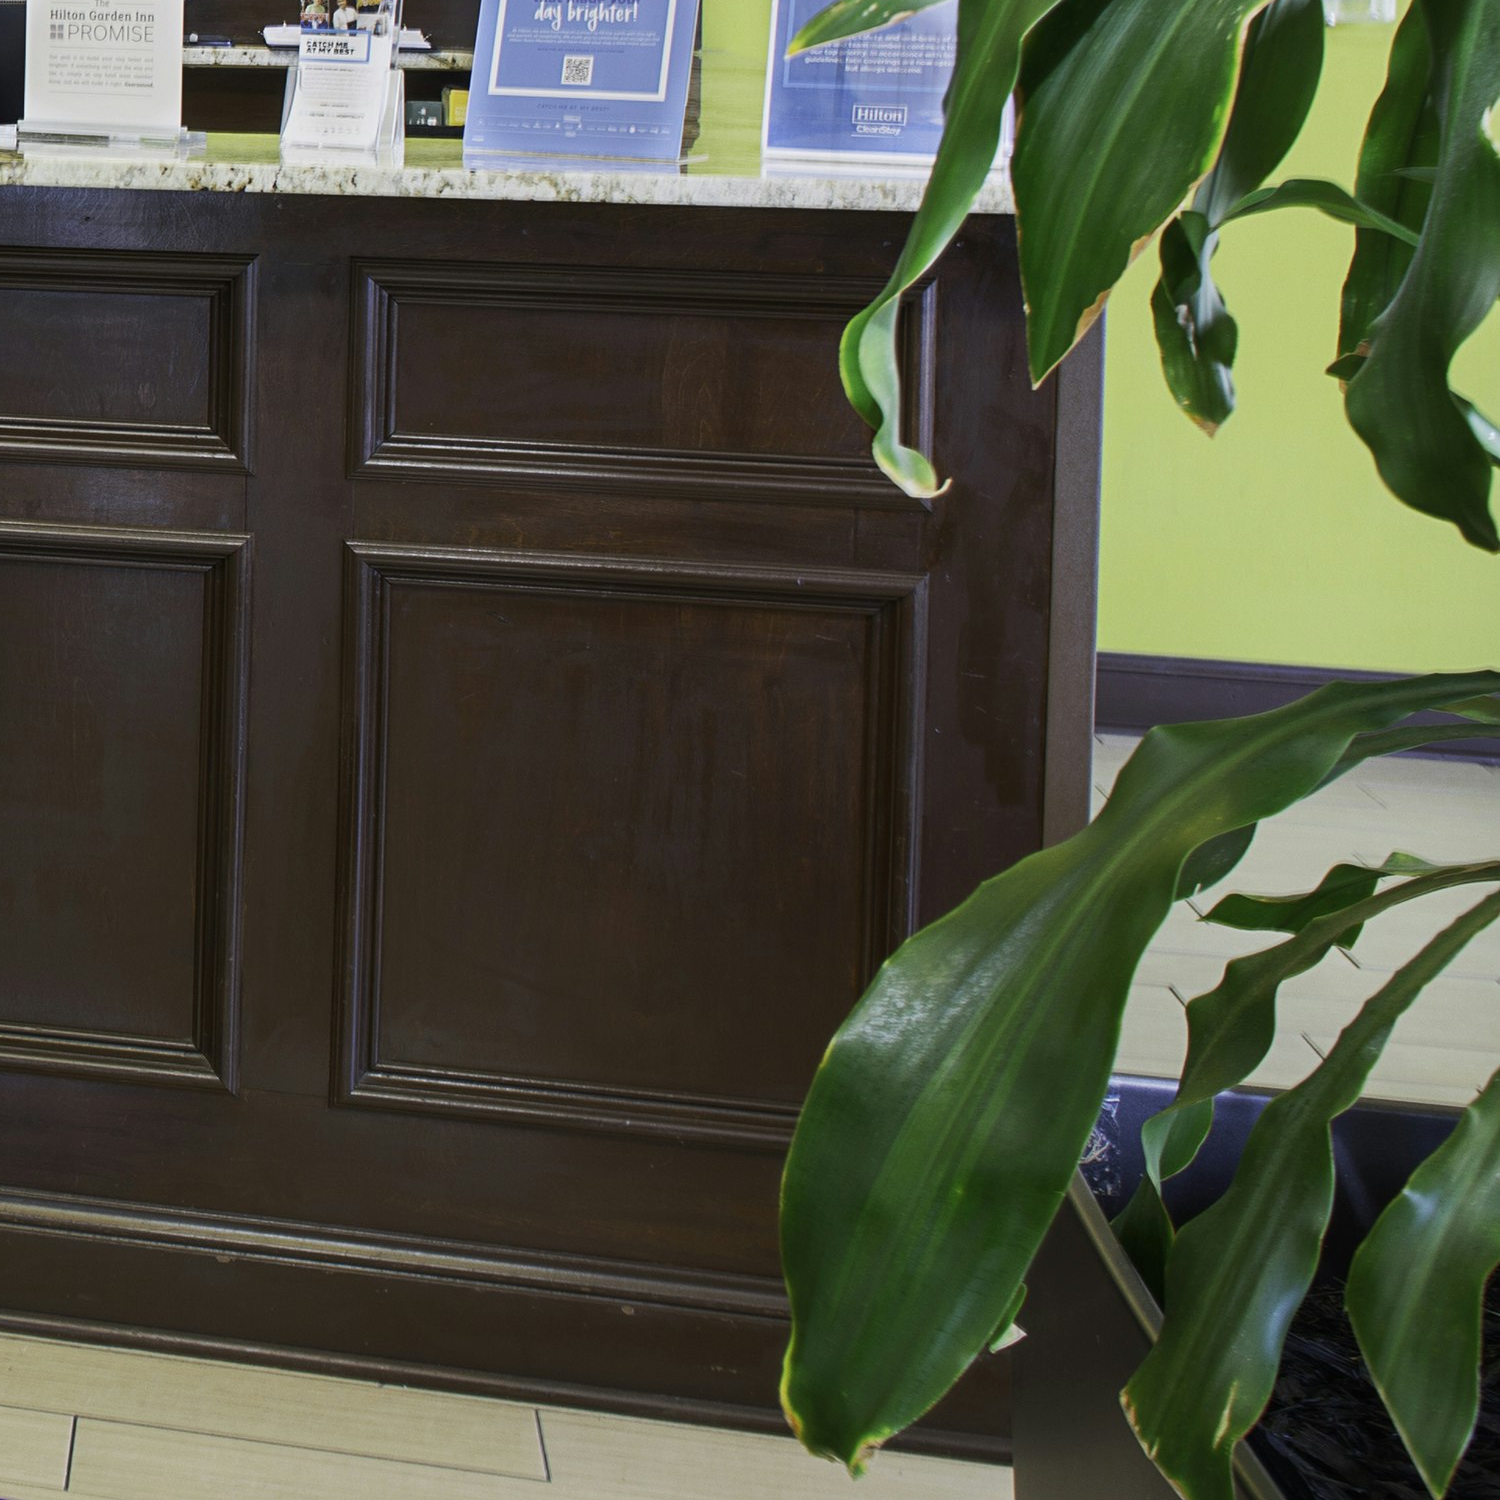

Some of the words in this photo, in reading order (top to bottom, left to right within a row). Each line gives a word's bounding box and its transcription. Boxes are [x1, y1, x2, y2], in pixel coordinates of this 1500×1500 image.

[50, 9, 86, 21] Hilton
[89, 10, 132, 22] Garden
[135, 11, 155, 22] Inn
[534, 0, 563, 31] day
[67, 23, 154, 43] PROMISE
[307, 40, 334, 49] CATCH
[857, 107, 903, 122] Hilton
[856, 125, 902, 136] CleanStay
